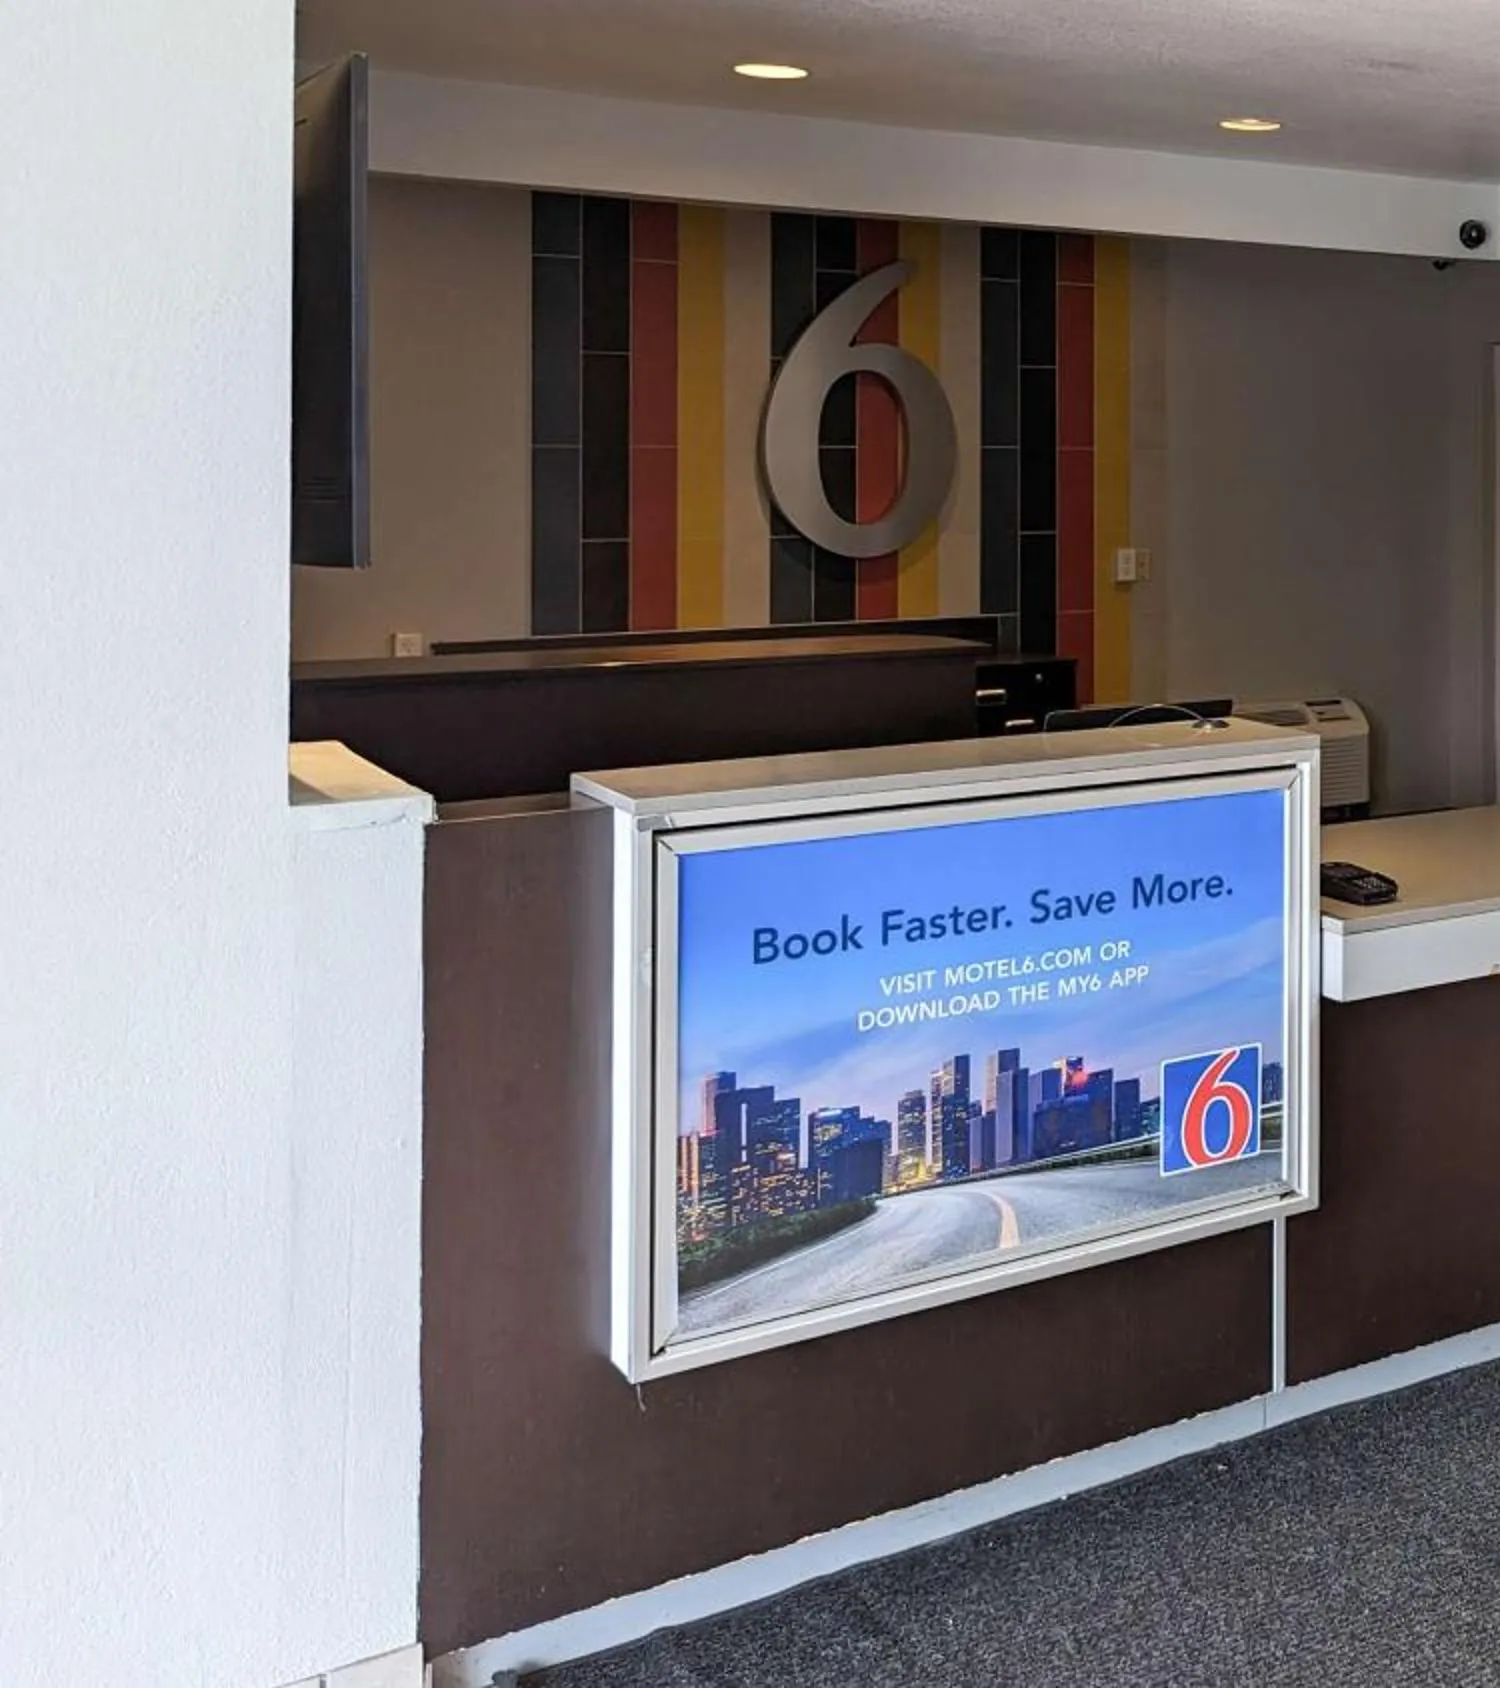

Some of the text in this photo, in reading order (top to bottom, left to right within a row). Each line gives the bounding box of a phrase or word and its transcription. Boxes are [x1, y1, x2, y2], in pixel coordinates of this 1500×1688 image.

[766, 260, 958, 558] 6
[754, 874, 1232, 964] Book Faster. Save More.
[858, 966, 1148, 1030] DOWNLOAD THE MY6 APP
[880, 940, 1130, 995] VISIT MOTEL6.COM OR
[1181, 1047, 1253, 1168] 6
